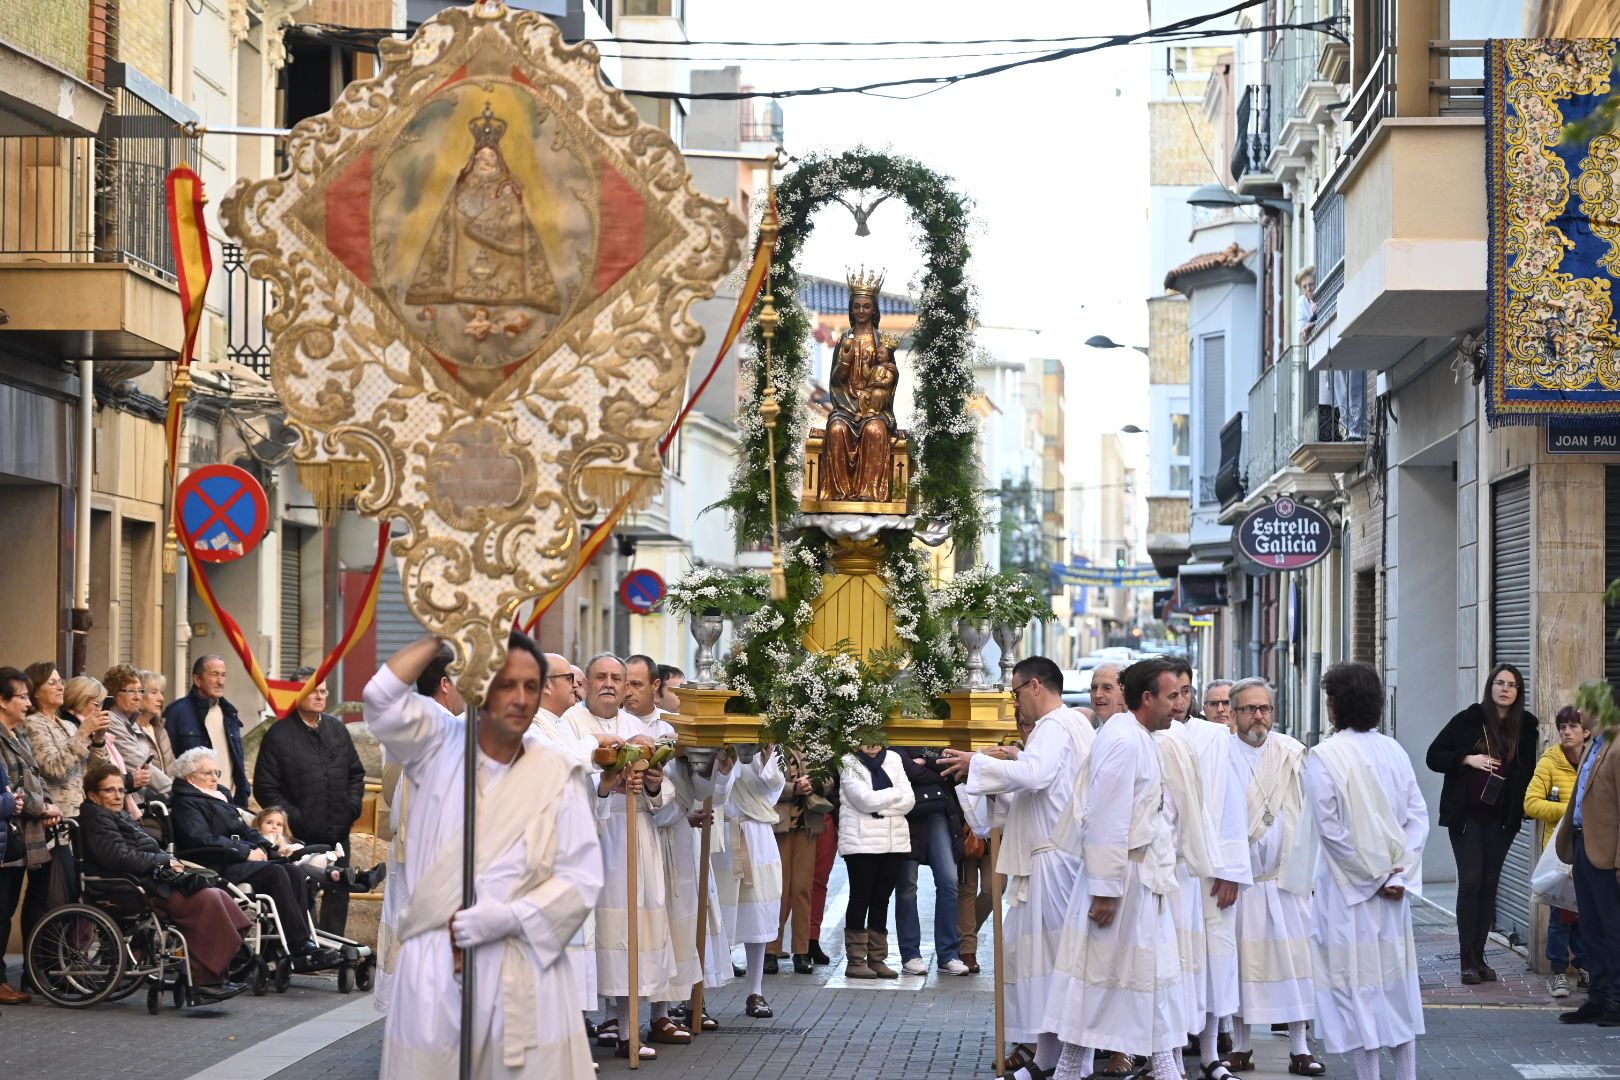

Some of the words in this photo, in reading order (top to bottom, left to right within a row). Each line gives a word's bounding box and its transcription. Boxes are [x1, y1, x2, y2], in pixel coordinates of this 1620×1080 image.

[1555, 435, 1587, 446] JOAN
[1593, 435, 1616, 446] PAU
[1252, 517, 1320, 535] Estrella
[1255, 535, 1317, 553] Galicia
